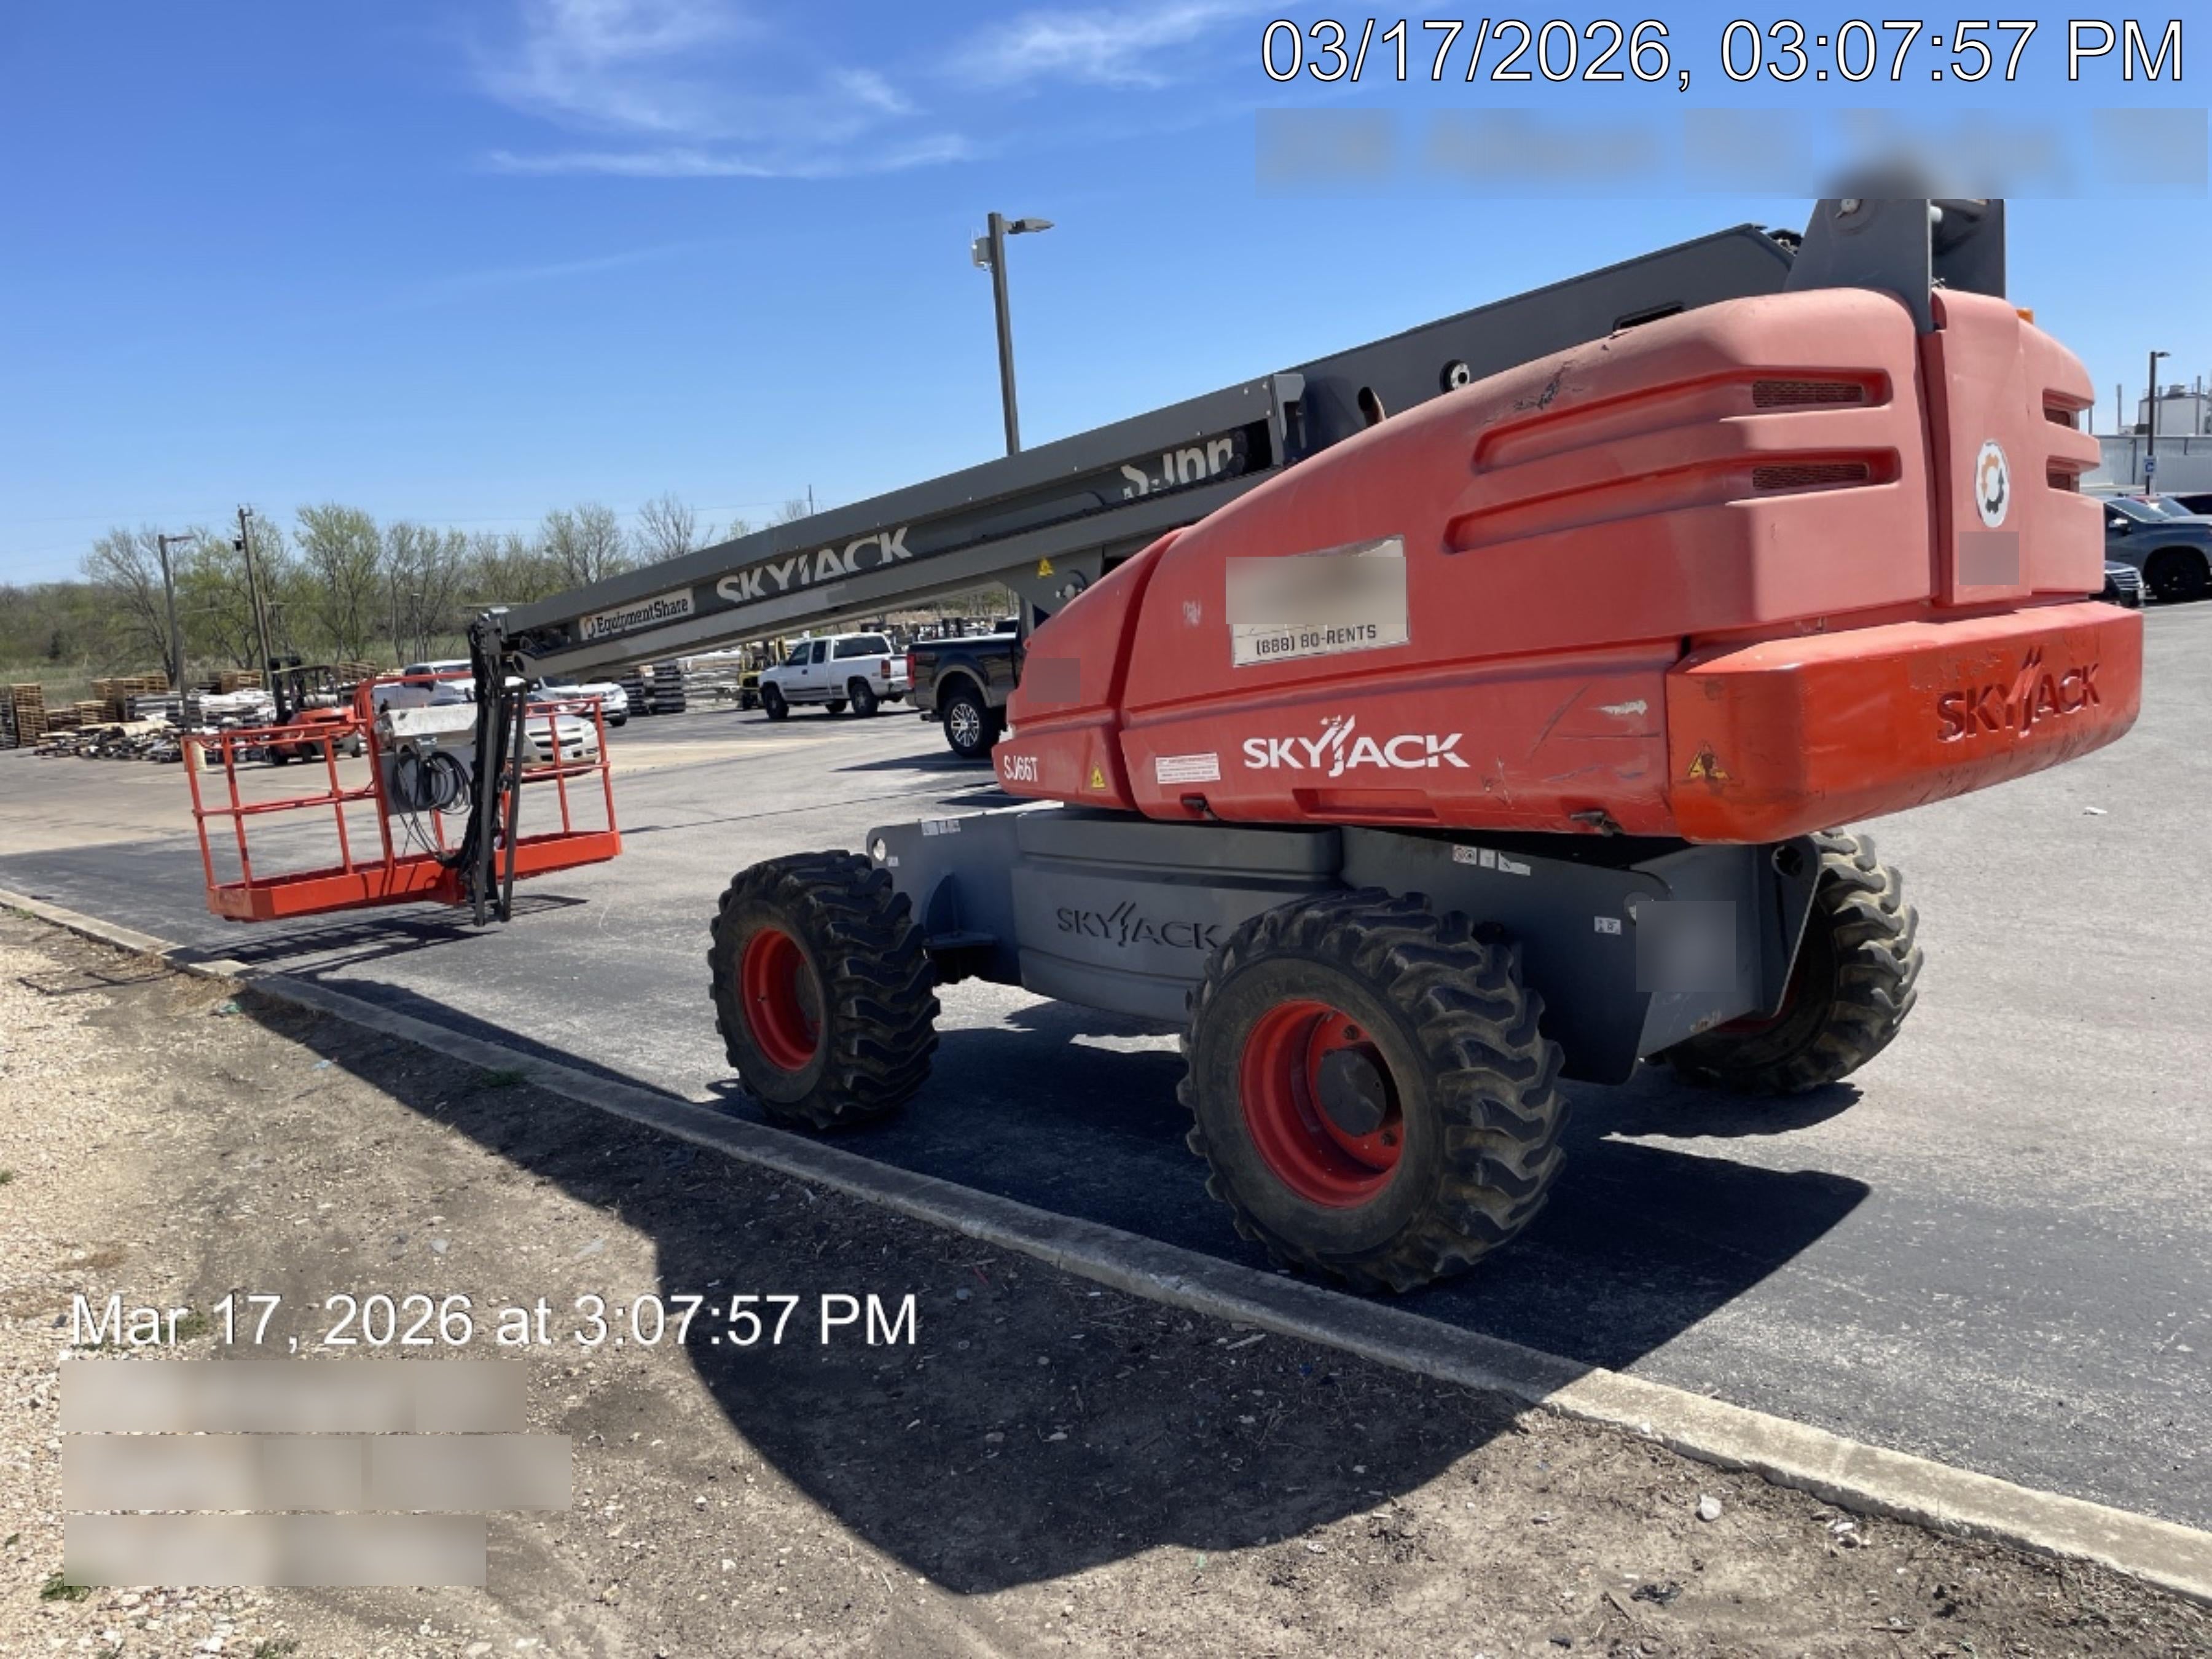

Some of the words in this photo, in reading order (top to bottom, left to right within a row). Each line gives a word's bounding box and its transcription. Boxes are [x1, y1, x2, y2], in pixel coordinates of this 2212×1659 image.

[595, 598, 688, 635] EquipmentShare
[1257, 635, 1295, 656] (888)
[1300, 624, 1376, 648] 80-RENTS
[1937, 646, 2101, 742] SKYJACK
[1242, 714, 1471, 777] SKYJACK
[1056, 901, 1222, 950] SKYJACK
